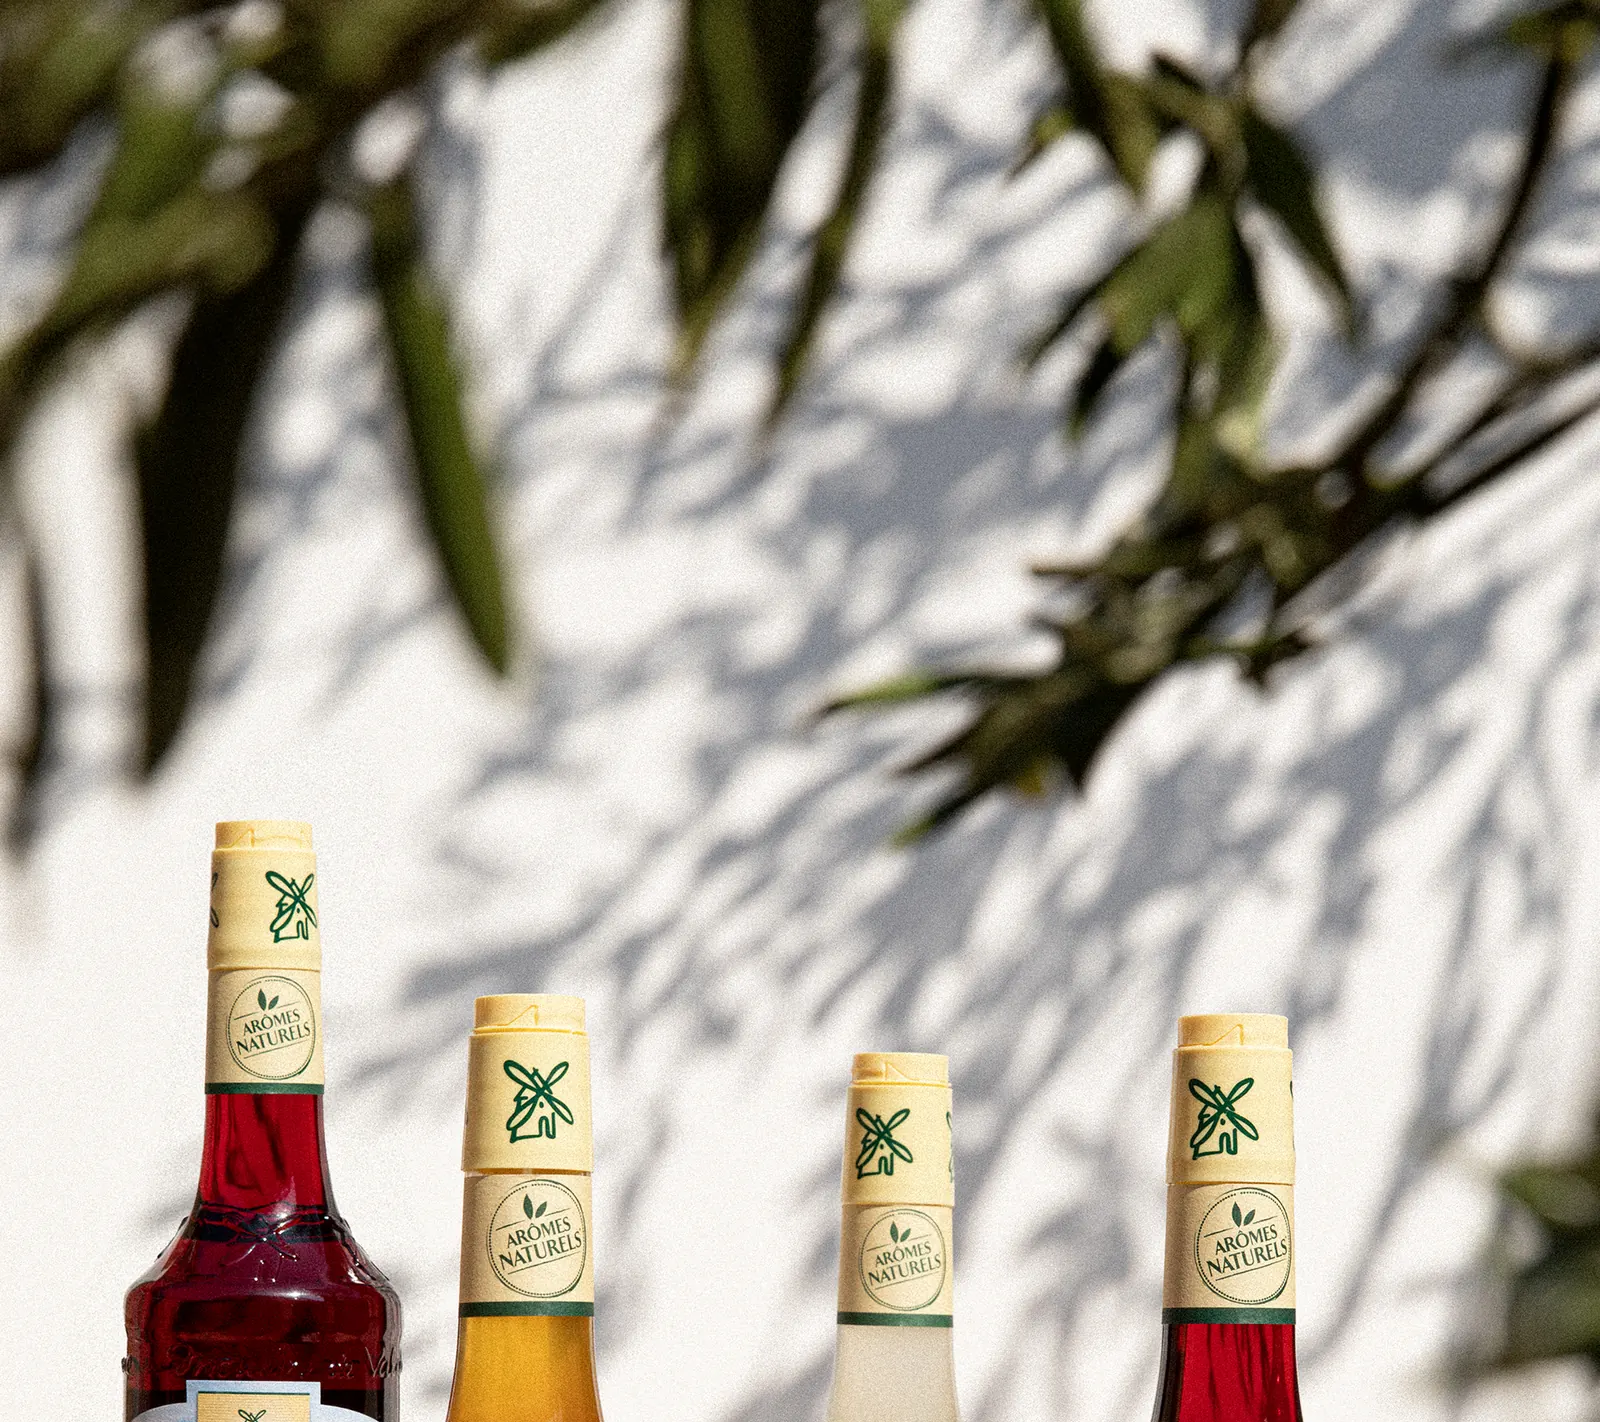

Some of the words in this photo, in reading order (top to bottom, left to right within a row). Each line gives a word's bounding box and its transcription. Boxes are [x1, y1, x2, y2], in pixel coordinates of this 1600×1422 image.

[236, 1021, 311, 1055] NATURELS
[243, 1008, 301, 1036] ARÔMES
[507, 1216, 571, 1248] ARÔMES
[1215, 1224, 1278, 1255] ARÔMES
[498, 1231, 582, 1271] NATURELS
[875, 1241, 932, 1267] ARÔMES
[1206, 1238, 1288, 1277] NATURELS
[868, 1253, 942, 1286] NATURELS
